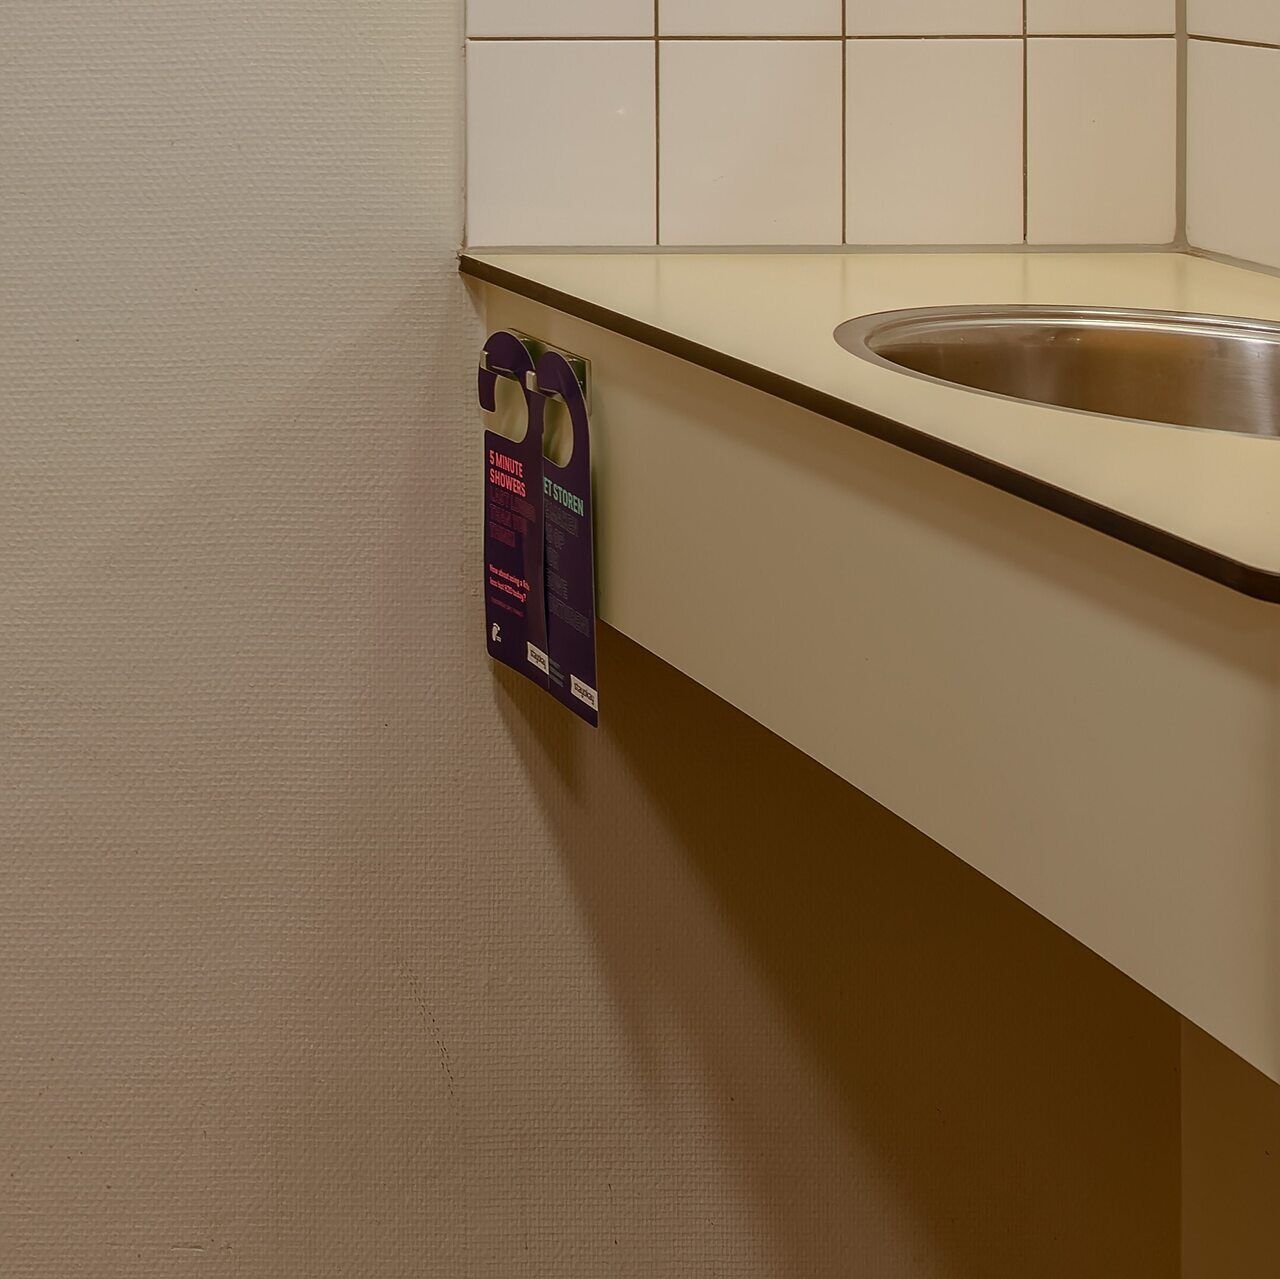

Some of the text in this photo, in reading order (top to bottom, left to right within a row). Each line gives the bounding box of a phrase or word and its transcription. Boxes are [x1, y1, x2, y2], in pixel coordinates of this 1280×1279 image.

[489, 449, 523, 478] 5 MINUTE
[489, 468, 526, 497] SHOWERS
[553, 483, 584, 517] STOREN
